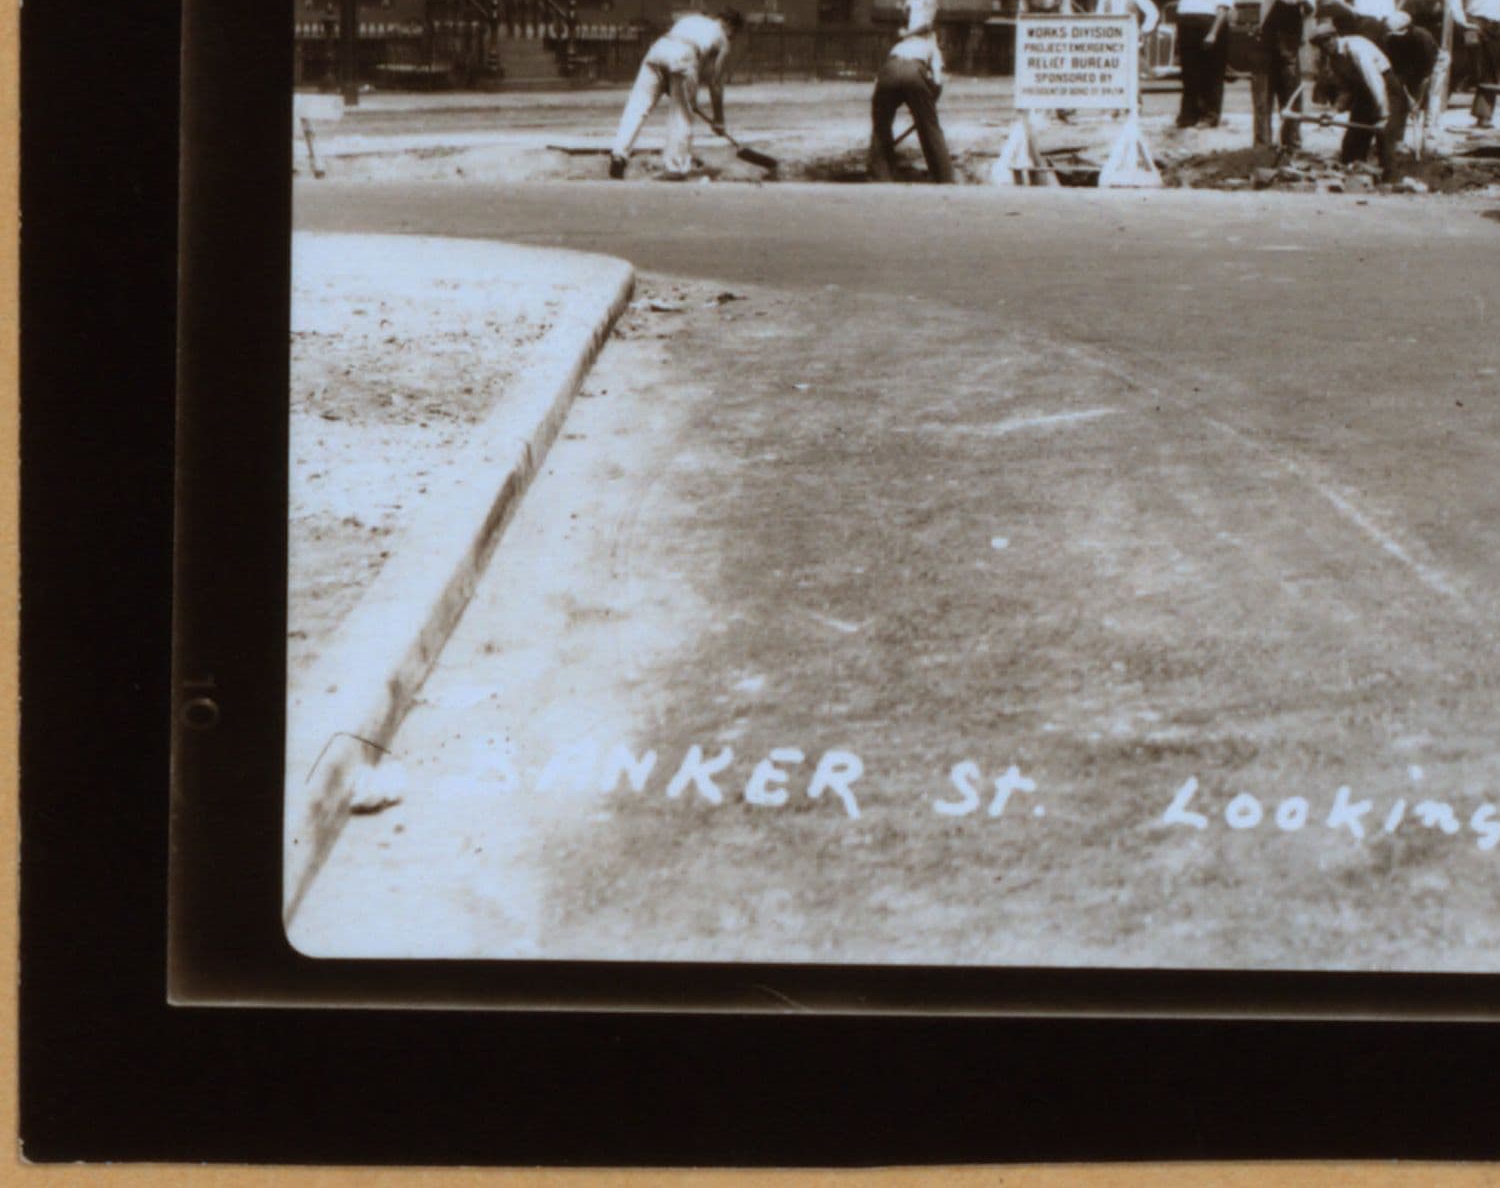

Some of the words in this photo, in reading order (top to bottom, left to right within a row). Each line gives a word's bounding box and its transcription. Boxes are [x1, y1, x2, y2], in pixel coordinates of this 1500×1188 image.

[1027, 26, 1067, 39] WORKS
[1071, 26, 1123, 39] DIVISION
[1024, 42, 1067, 53] PROJECT
[1069, 42, 1125, 53] EMERGENCY
[1027, 56, 1065, 69] RELIEF
[1071, 56, 1120, 69] BUREAU
[1034, 72, 1097, 84] SPONSORED
